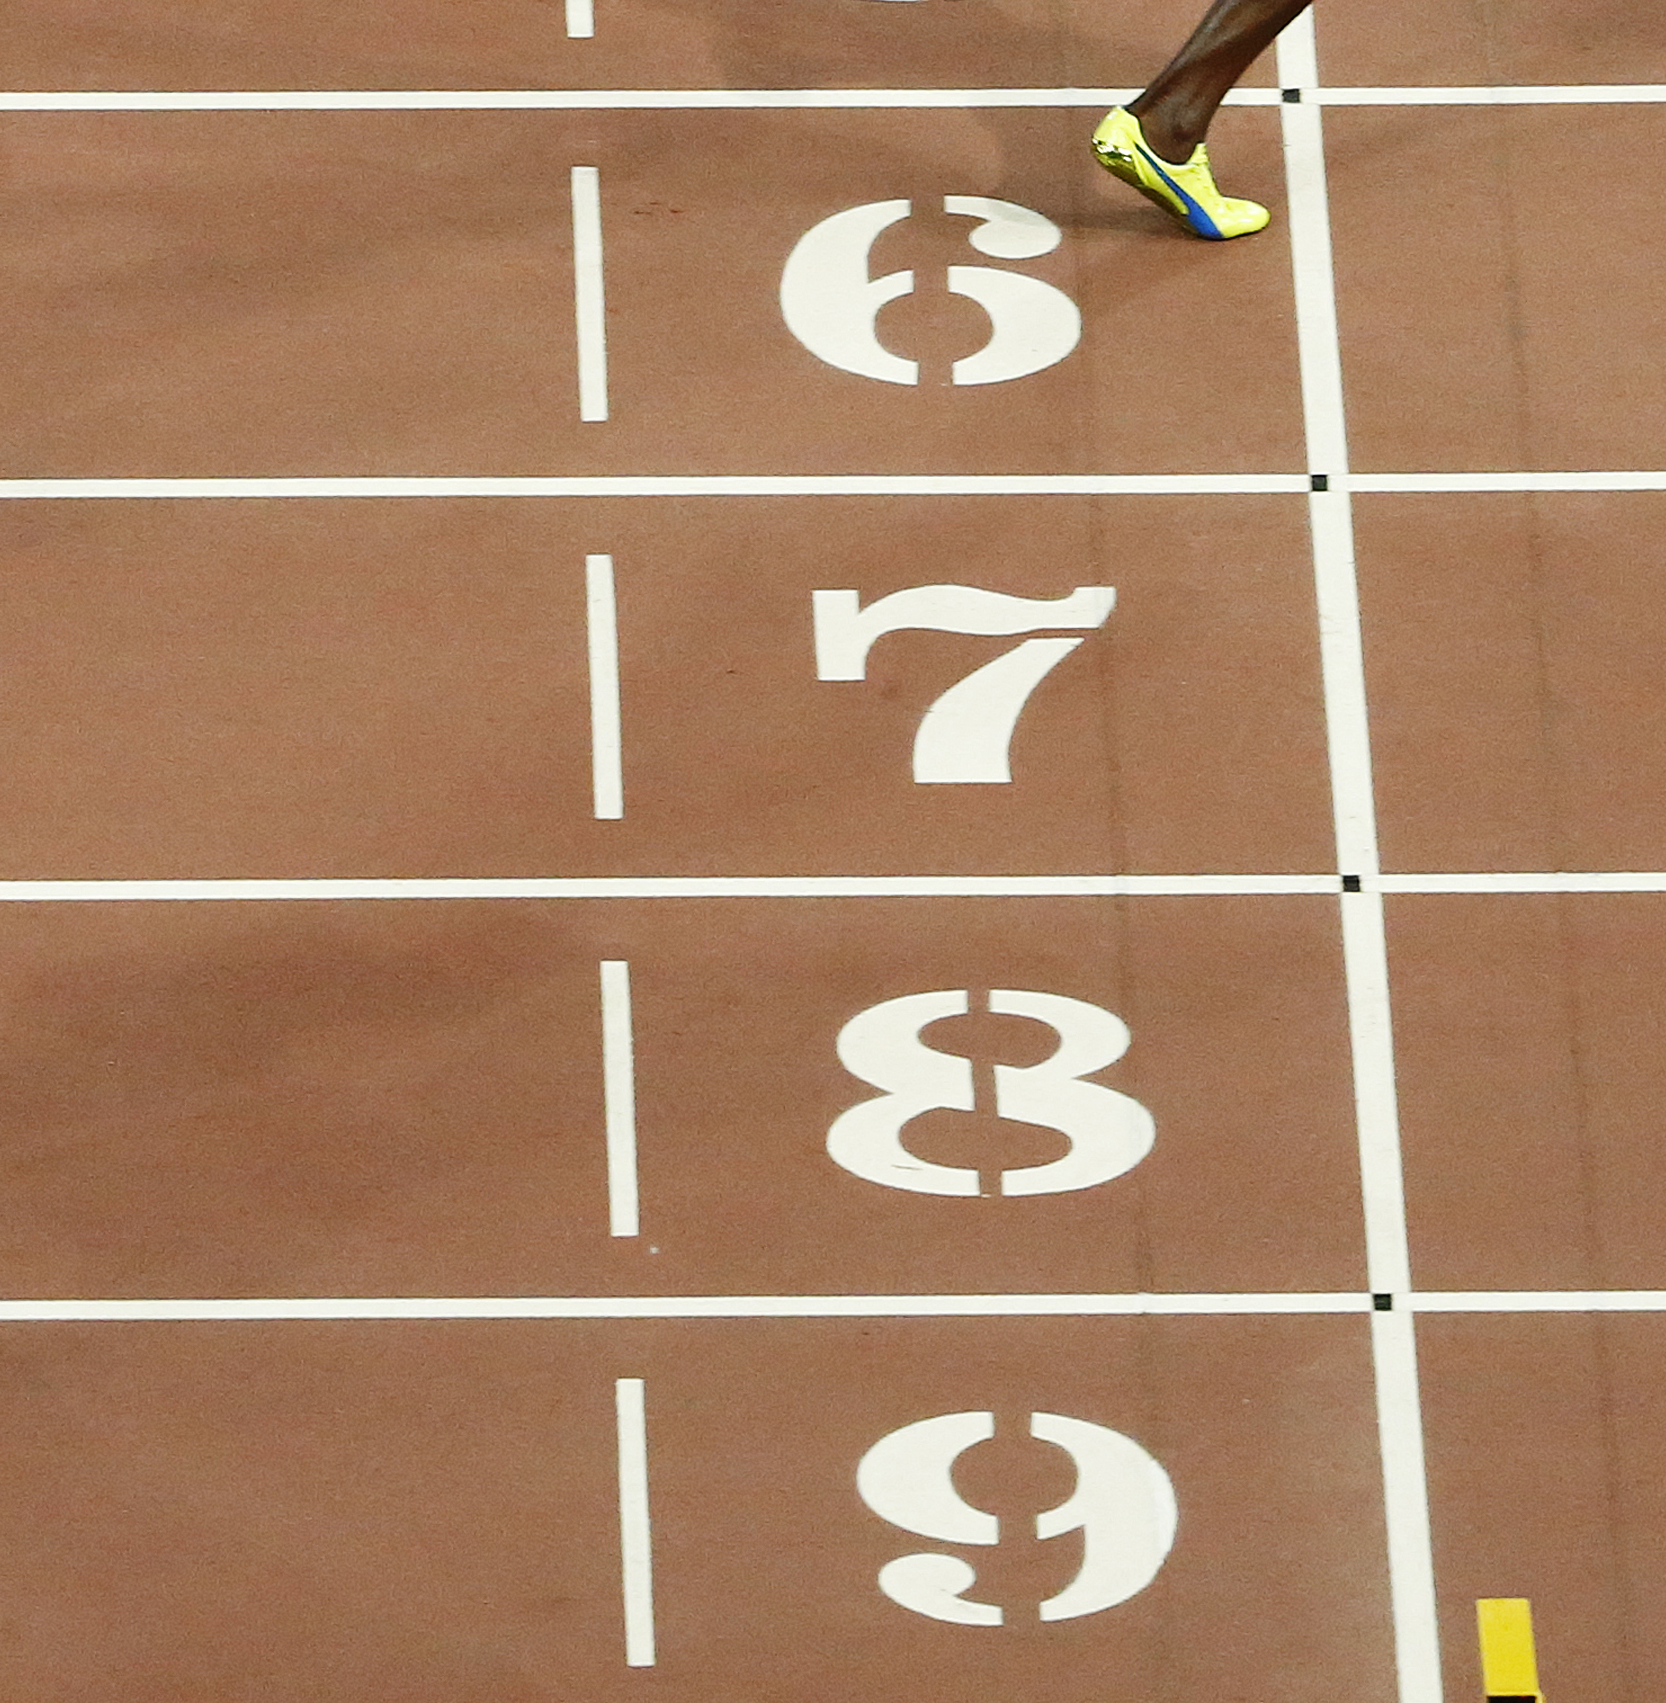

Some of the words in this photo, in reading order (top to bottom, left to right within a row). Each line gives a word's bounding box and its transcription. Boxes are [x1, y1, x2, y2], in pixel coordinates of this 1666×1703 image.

[778, 196, 1082, 386] 6
[812, 584, 1118, 785] 7
[826, 989, 1157, 1197] 8
[855, 1411, 1182, 1627] 9
